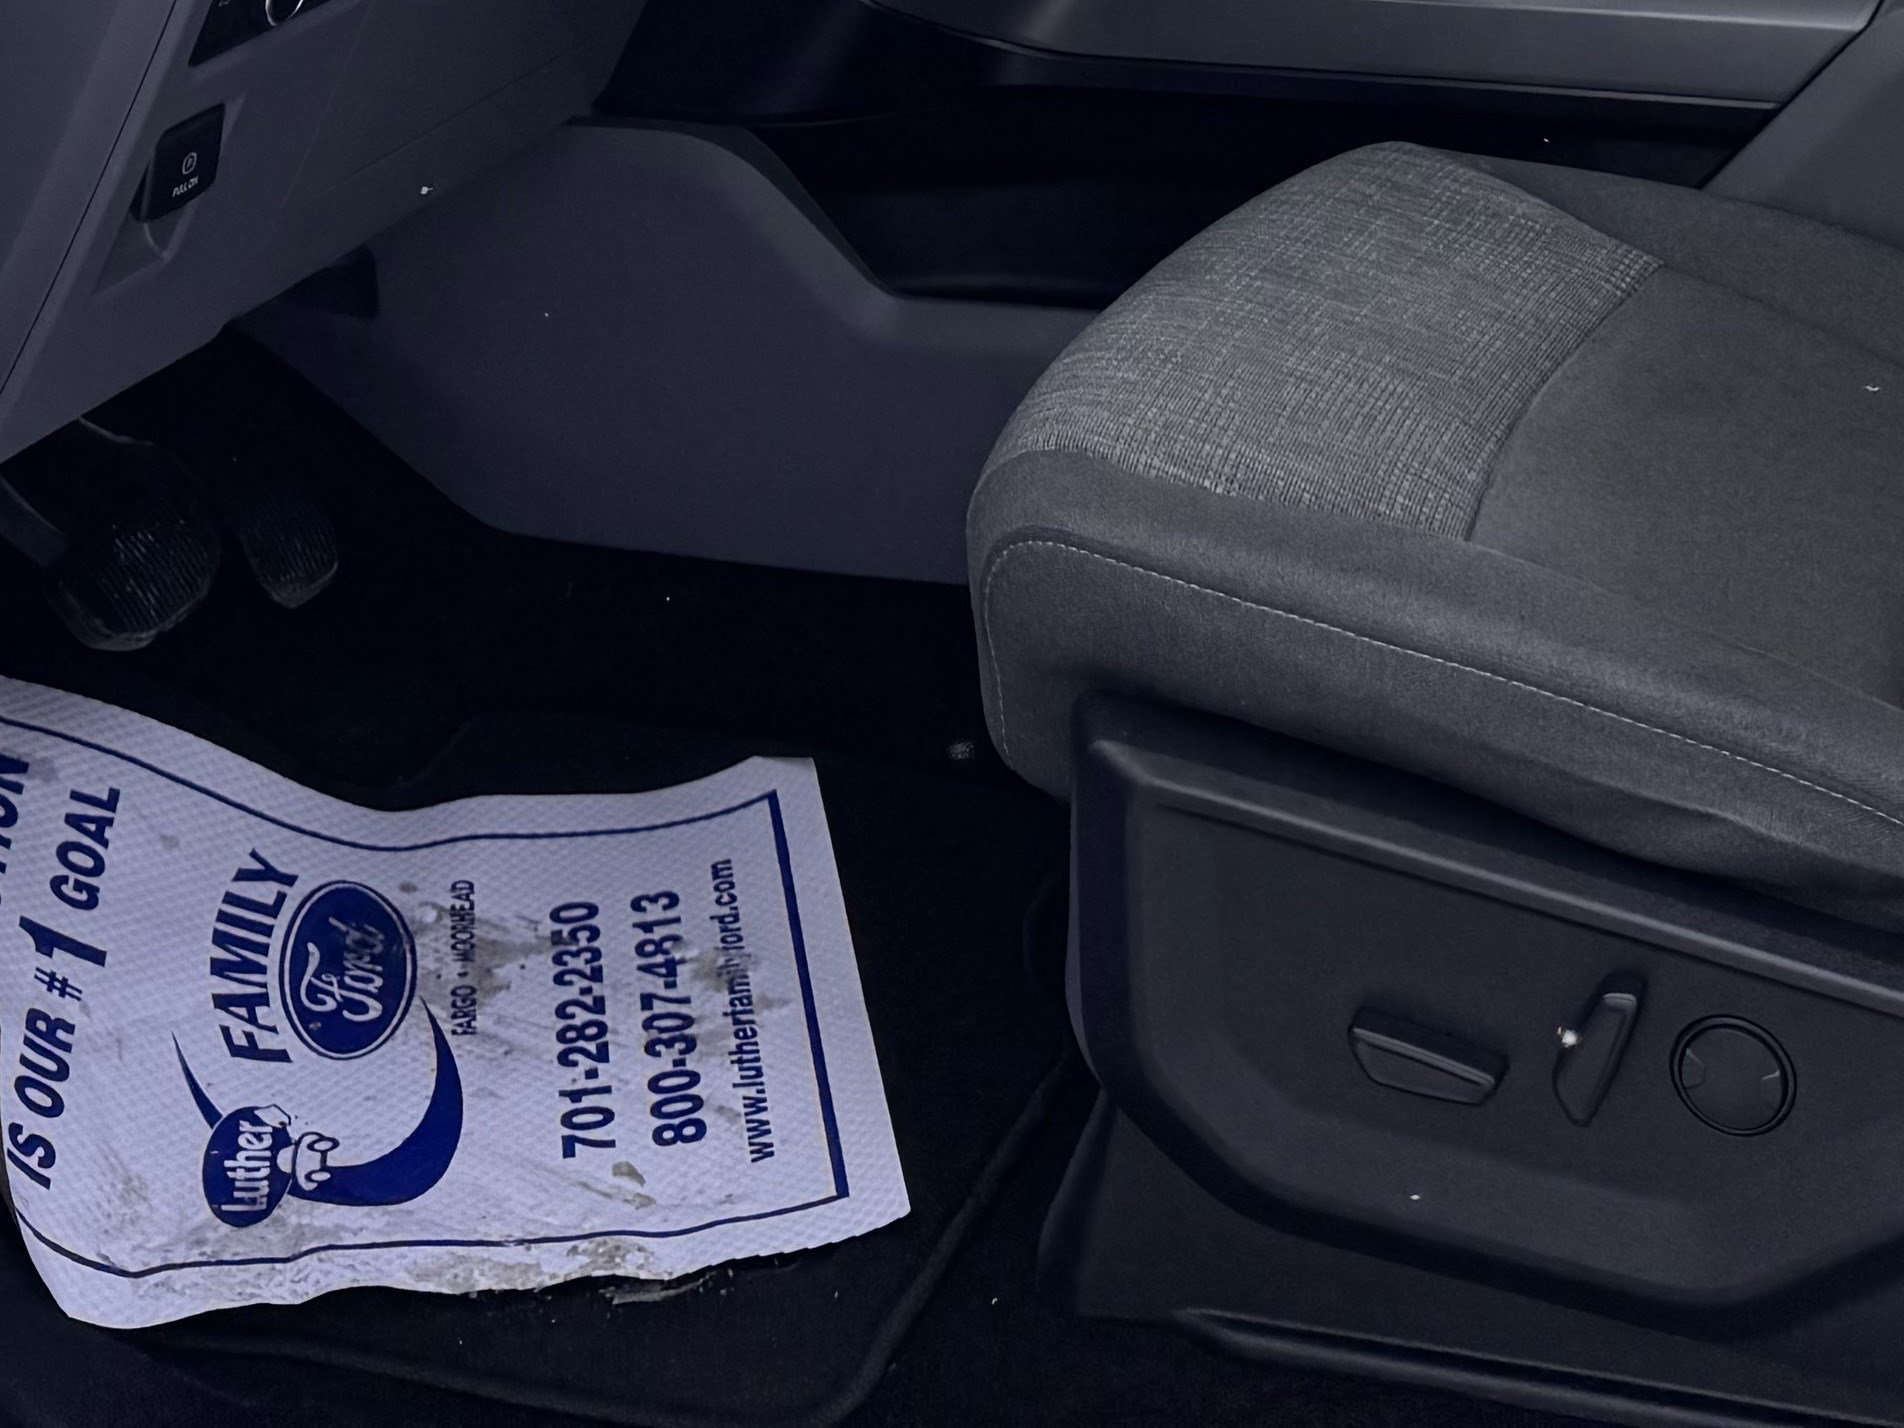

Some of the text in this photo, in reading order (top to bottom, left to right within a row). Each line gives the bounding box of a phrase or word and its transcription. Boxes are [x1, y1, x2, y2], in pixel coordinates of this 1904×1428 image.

[7, 787, 121, 1190] IS OUR #1 GOAL
[209, 847, 299, 1064] FAMILY
[299, 916, 385, 1023] Ford
[451, 984, 478, 1036] FARGO
[549, 901, 617, 1159] 701-282-2350
[630, 890, 708, 1147] 800-307-4813
[221, 1119, 275, 1212] Luther
